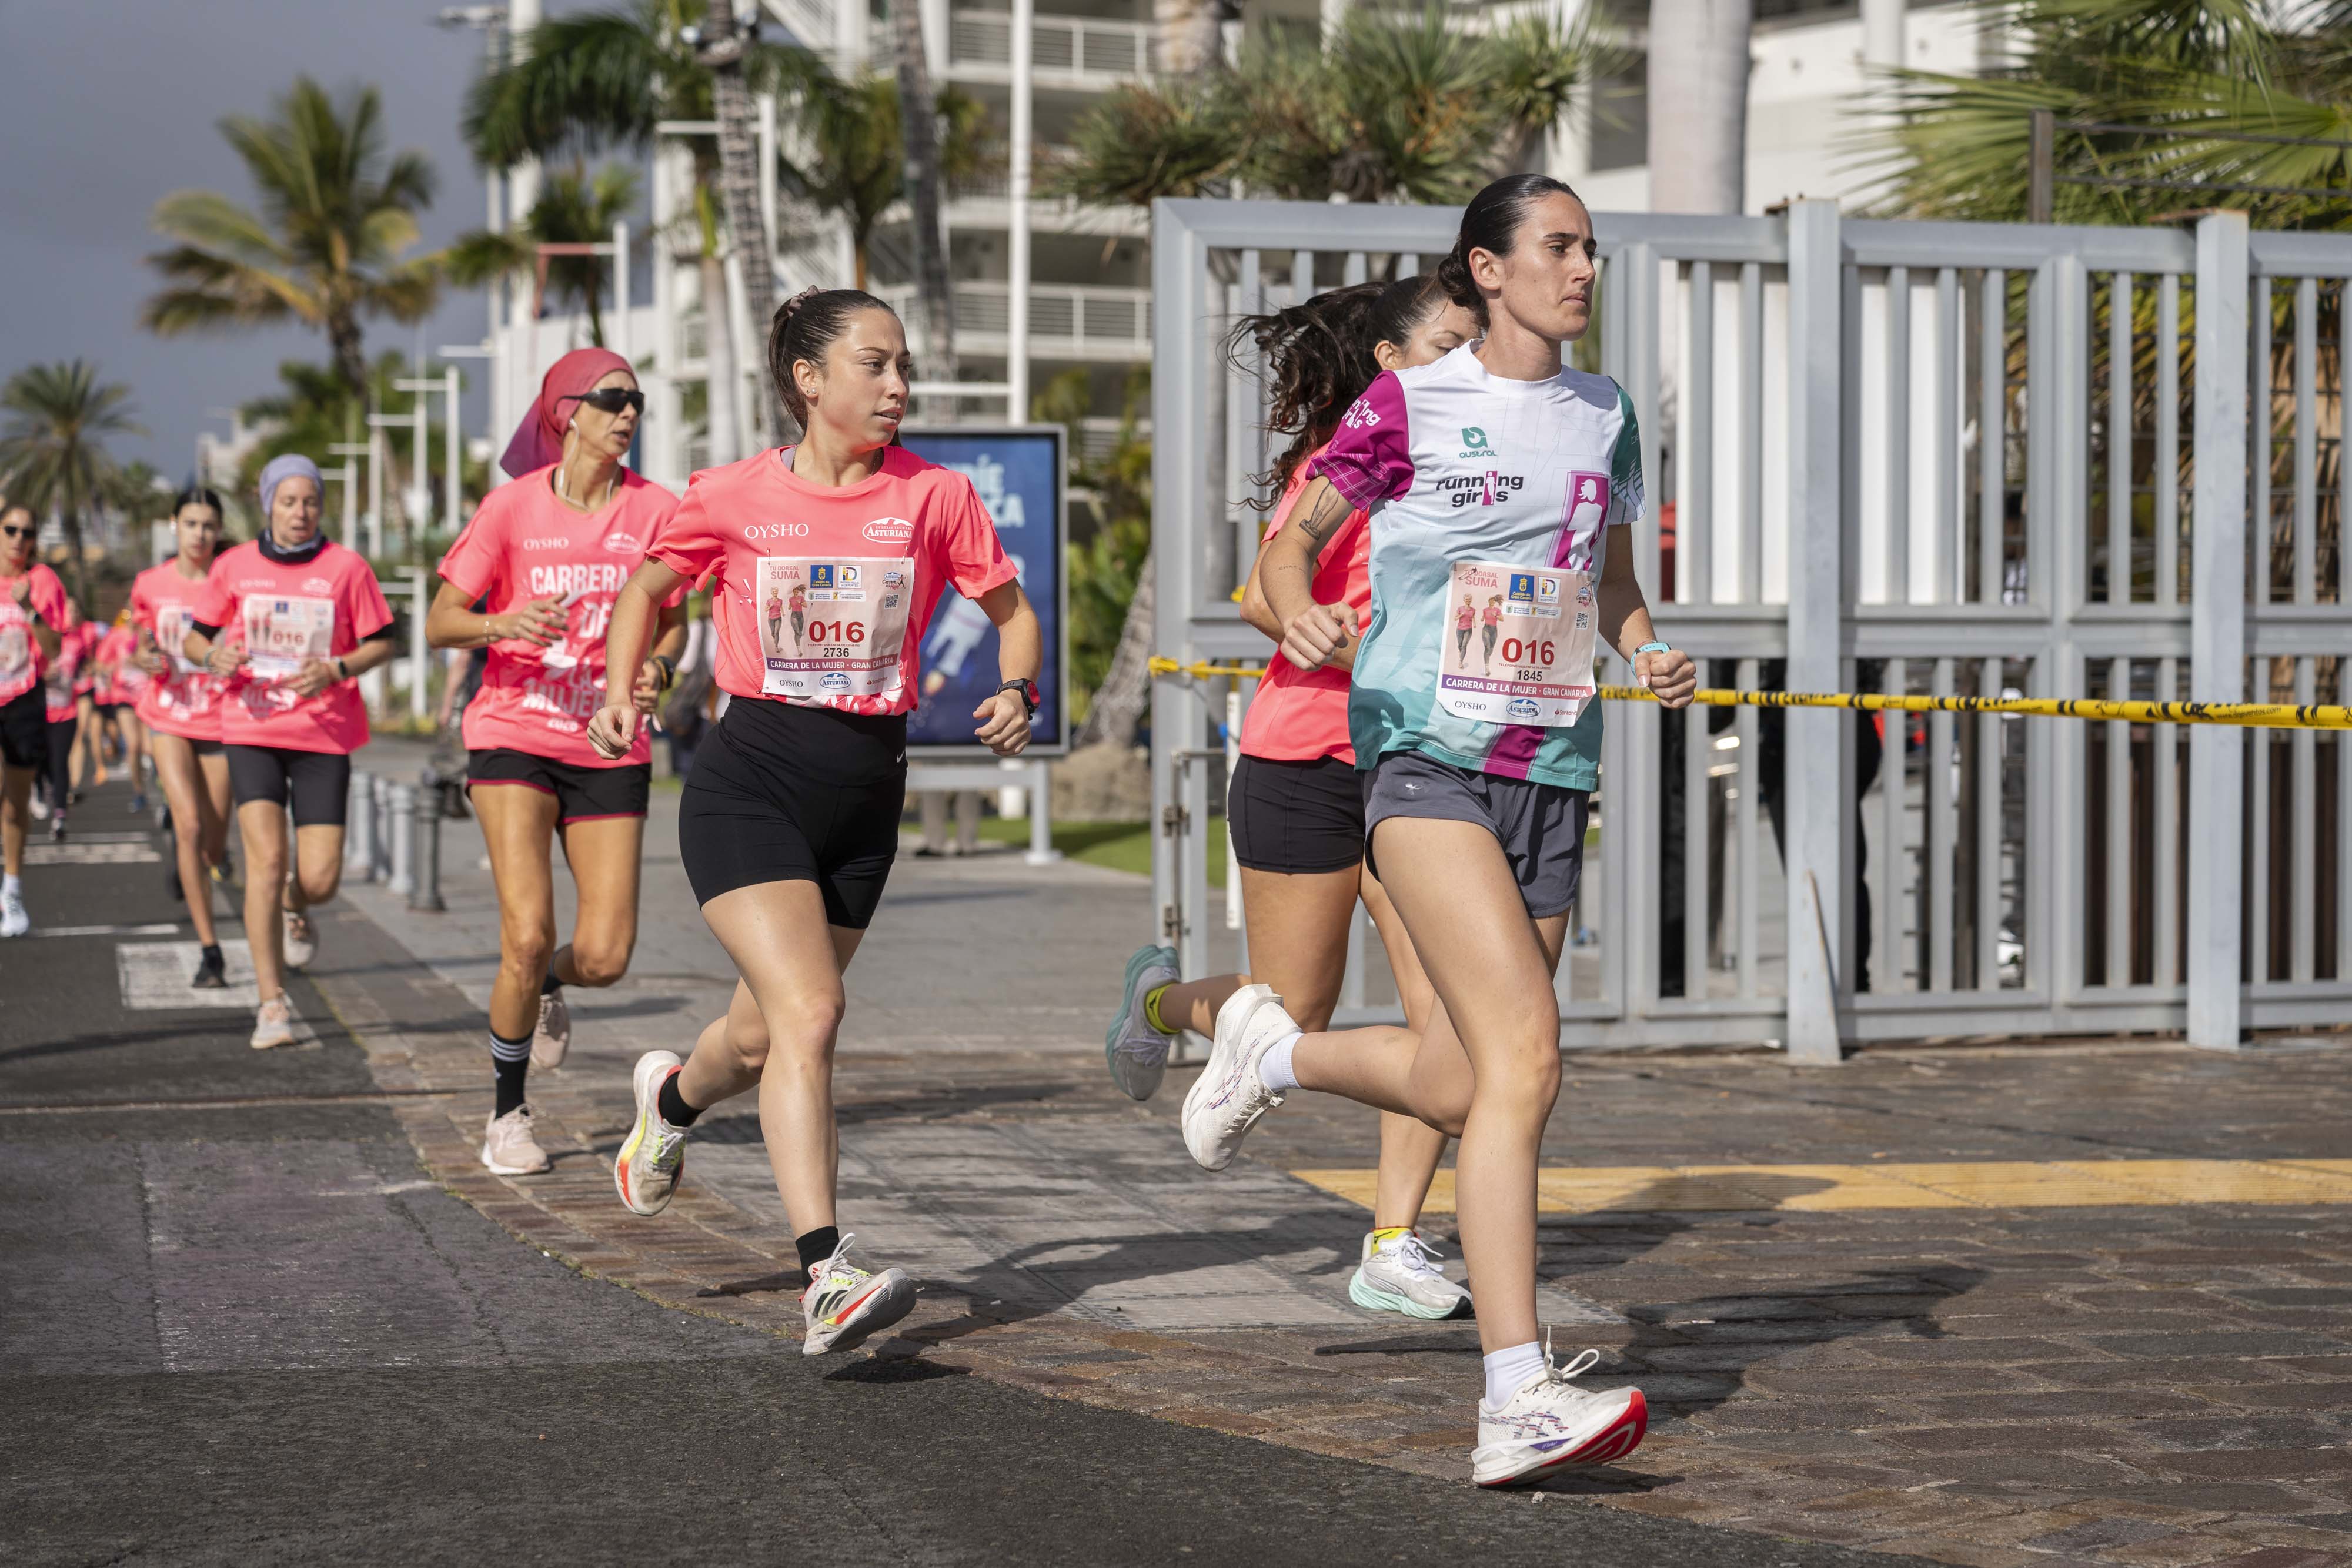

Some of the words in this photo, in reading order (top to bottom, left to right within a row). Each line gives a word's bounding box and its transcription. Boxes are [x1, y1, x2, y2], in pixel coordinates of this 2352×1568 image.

[1459, 450, 1498, 459] austral
[744, 523, 809, 539] OYSHO
[867, 527, 913, 539] ASTURIANA
[523, 536, 569, 551] OYSHO
[771, 571, 800, 579] SUMA
[1465, 576, 1498, 589] SUMA
[808, 621, 865, 643] 016
[823, 647, 850, 657] 2736
[1502, 638, 1555, 666] 016
[770, 660, 799, 669] CARRERA
[851, 661, 871, 669] GRAN
[873, 657, 893, 668] CANARIA
[1517, 670, 1543, 681] 1845
[779, 679, 803, 688] OYSHO
[1446, 678, 1484, 690] CARRERA
[1486, 681, 1497, 691] DE
[1499, 683, 1509, 693] LA
[1512, 684, 1537, 696] MUJER
[1543, 687, 1559, 696] GRAN
[1561, 688, 1587, 697] CANARIA
[1454, 700, 1486, 711] OYSHO
